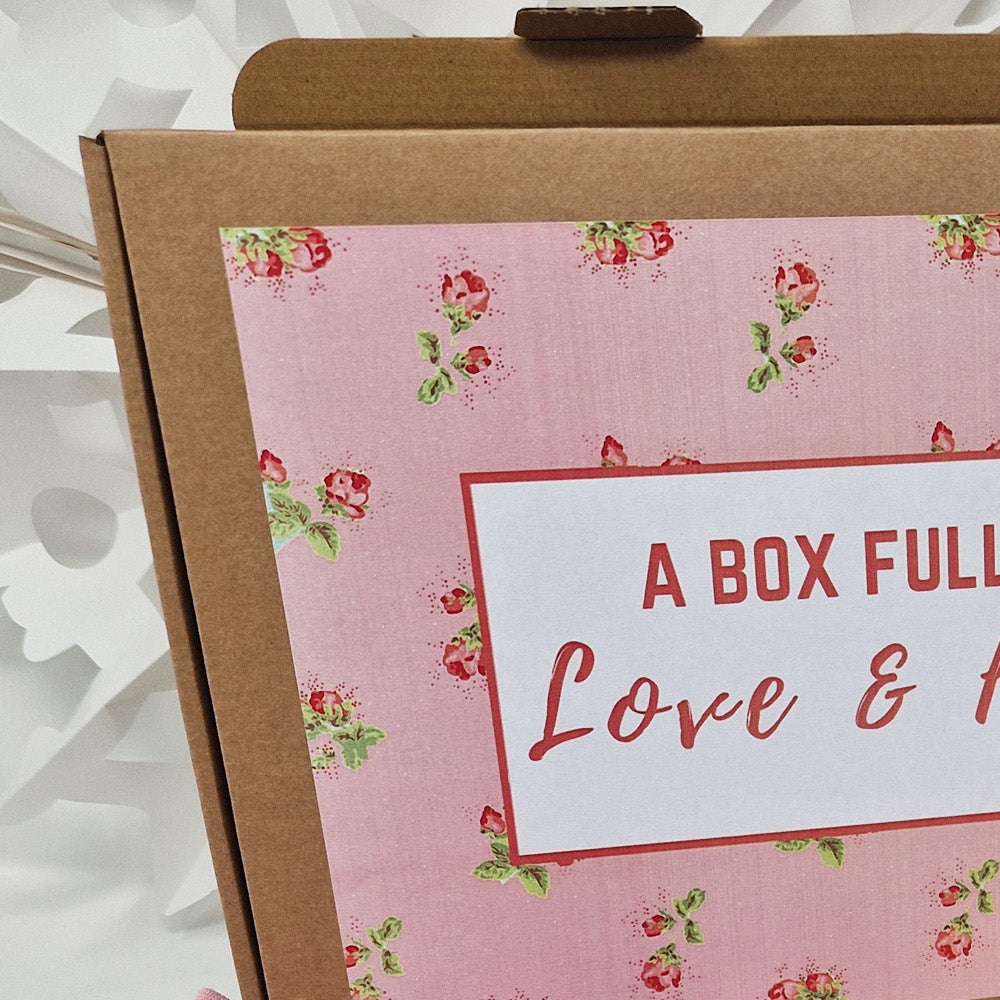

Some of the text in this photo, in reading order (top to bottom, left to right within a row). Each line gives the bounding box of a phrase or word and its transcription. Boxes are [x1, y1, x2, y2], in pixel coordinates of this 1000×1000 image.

[642, 542, 687, 610] A
[709, 533, 836, 605] BOX
[528, 640, 798, 762] Love
[854, 642, 917, 731] &
